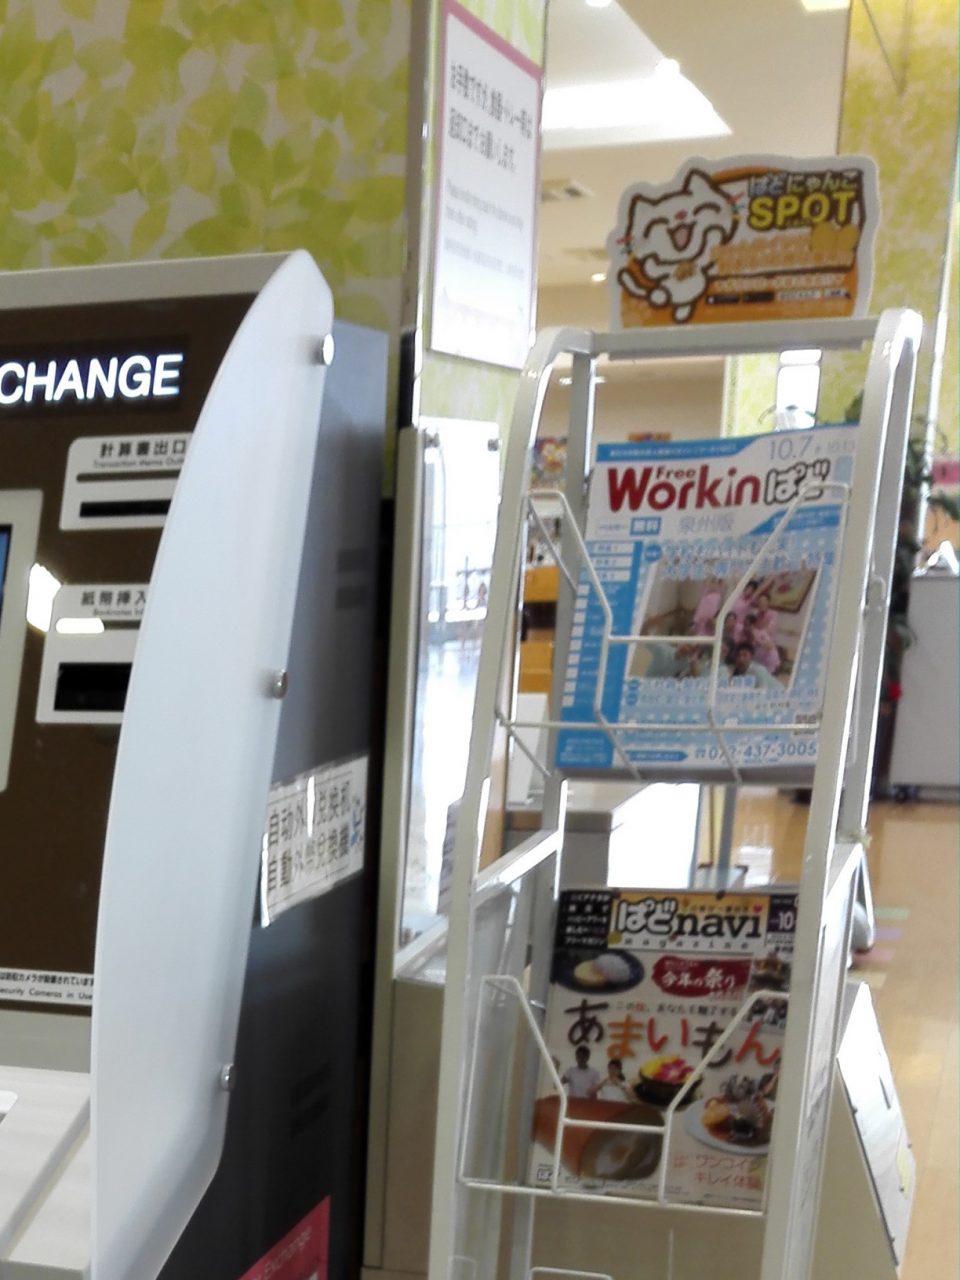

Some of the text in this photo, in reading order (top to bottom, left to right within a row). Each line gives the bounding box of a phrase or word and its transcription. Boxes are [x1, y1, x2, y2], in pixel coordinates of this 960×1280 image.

[749, 190, 856, 230] SPOT
[607, 464, 762, 513] Workin
[656, 466, 697, 480] Free
[269, 780, 352, 847] 自动外兑换机
[778, 910, 795, 930] 10
[29, 988, 62, 998] Cameras
[564, 998, 782, 1069] あまいもん
